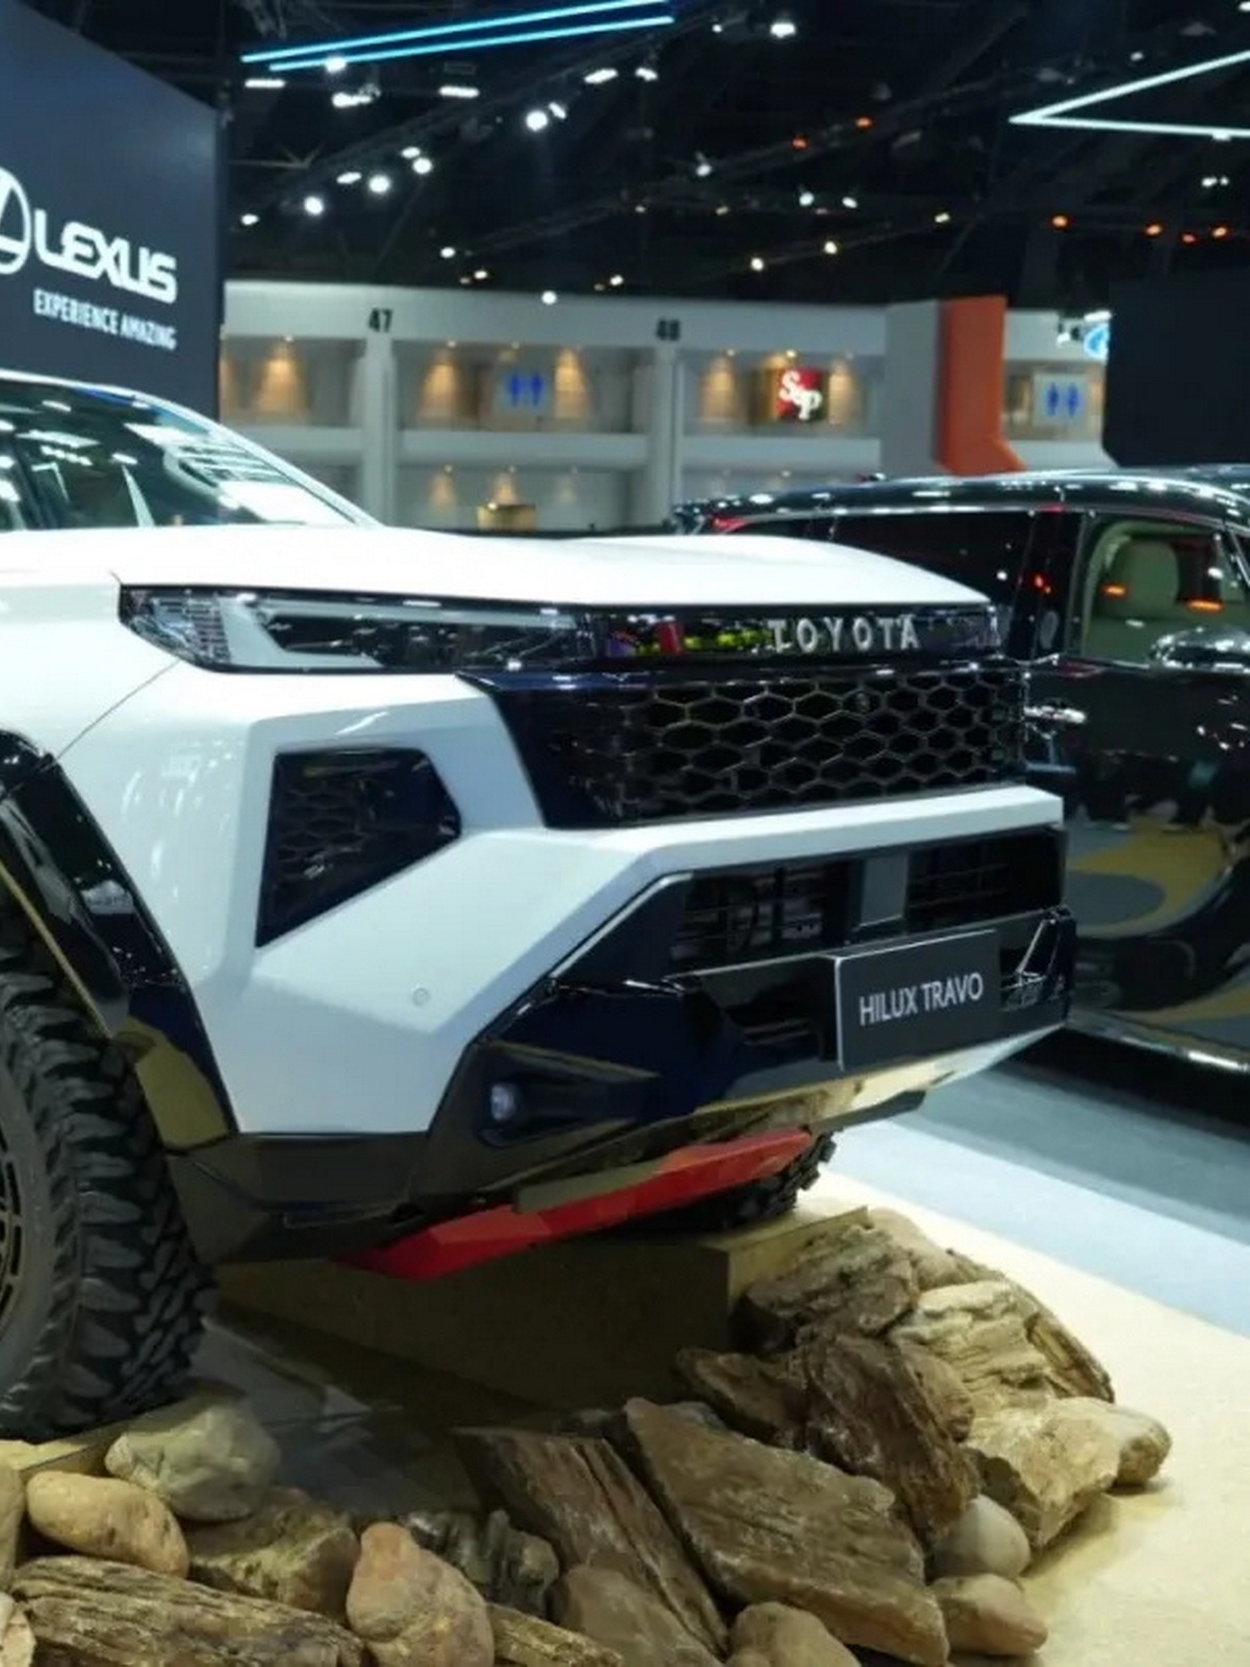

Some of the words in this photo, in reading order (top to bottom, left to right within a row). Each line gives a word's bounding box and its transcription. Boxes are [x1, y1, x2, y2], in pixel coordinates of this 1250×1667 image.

[35, 208, 177, 304] LEXUS
[33, 288, 119, 335] EXPERIENCE
[120, 313, 177, 350] AMAZING
[368, 308, 393, 333] 47
[767, 614, 919, 653] TOYOTA
[859, 986, 918, 1026] HILUX
[920, 972, 984, 1012] TRAVO
